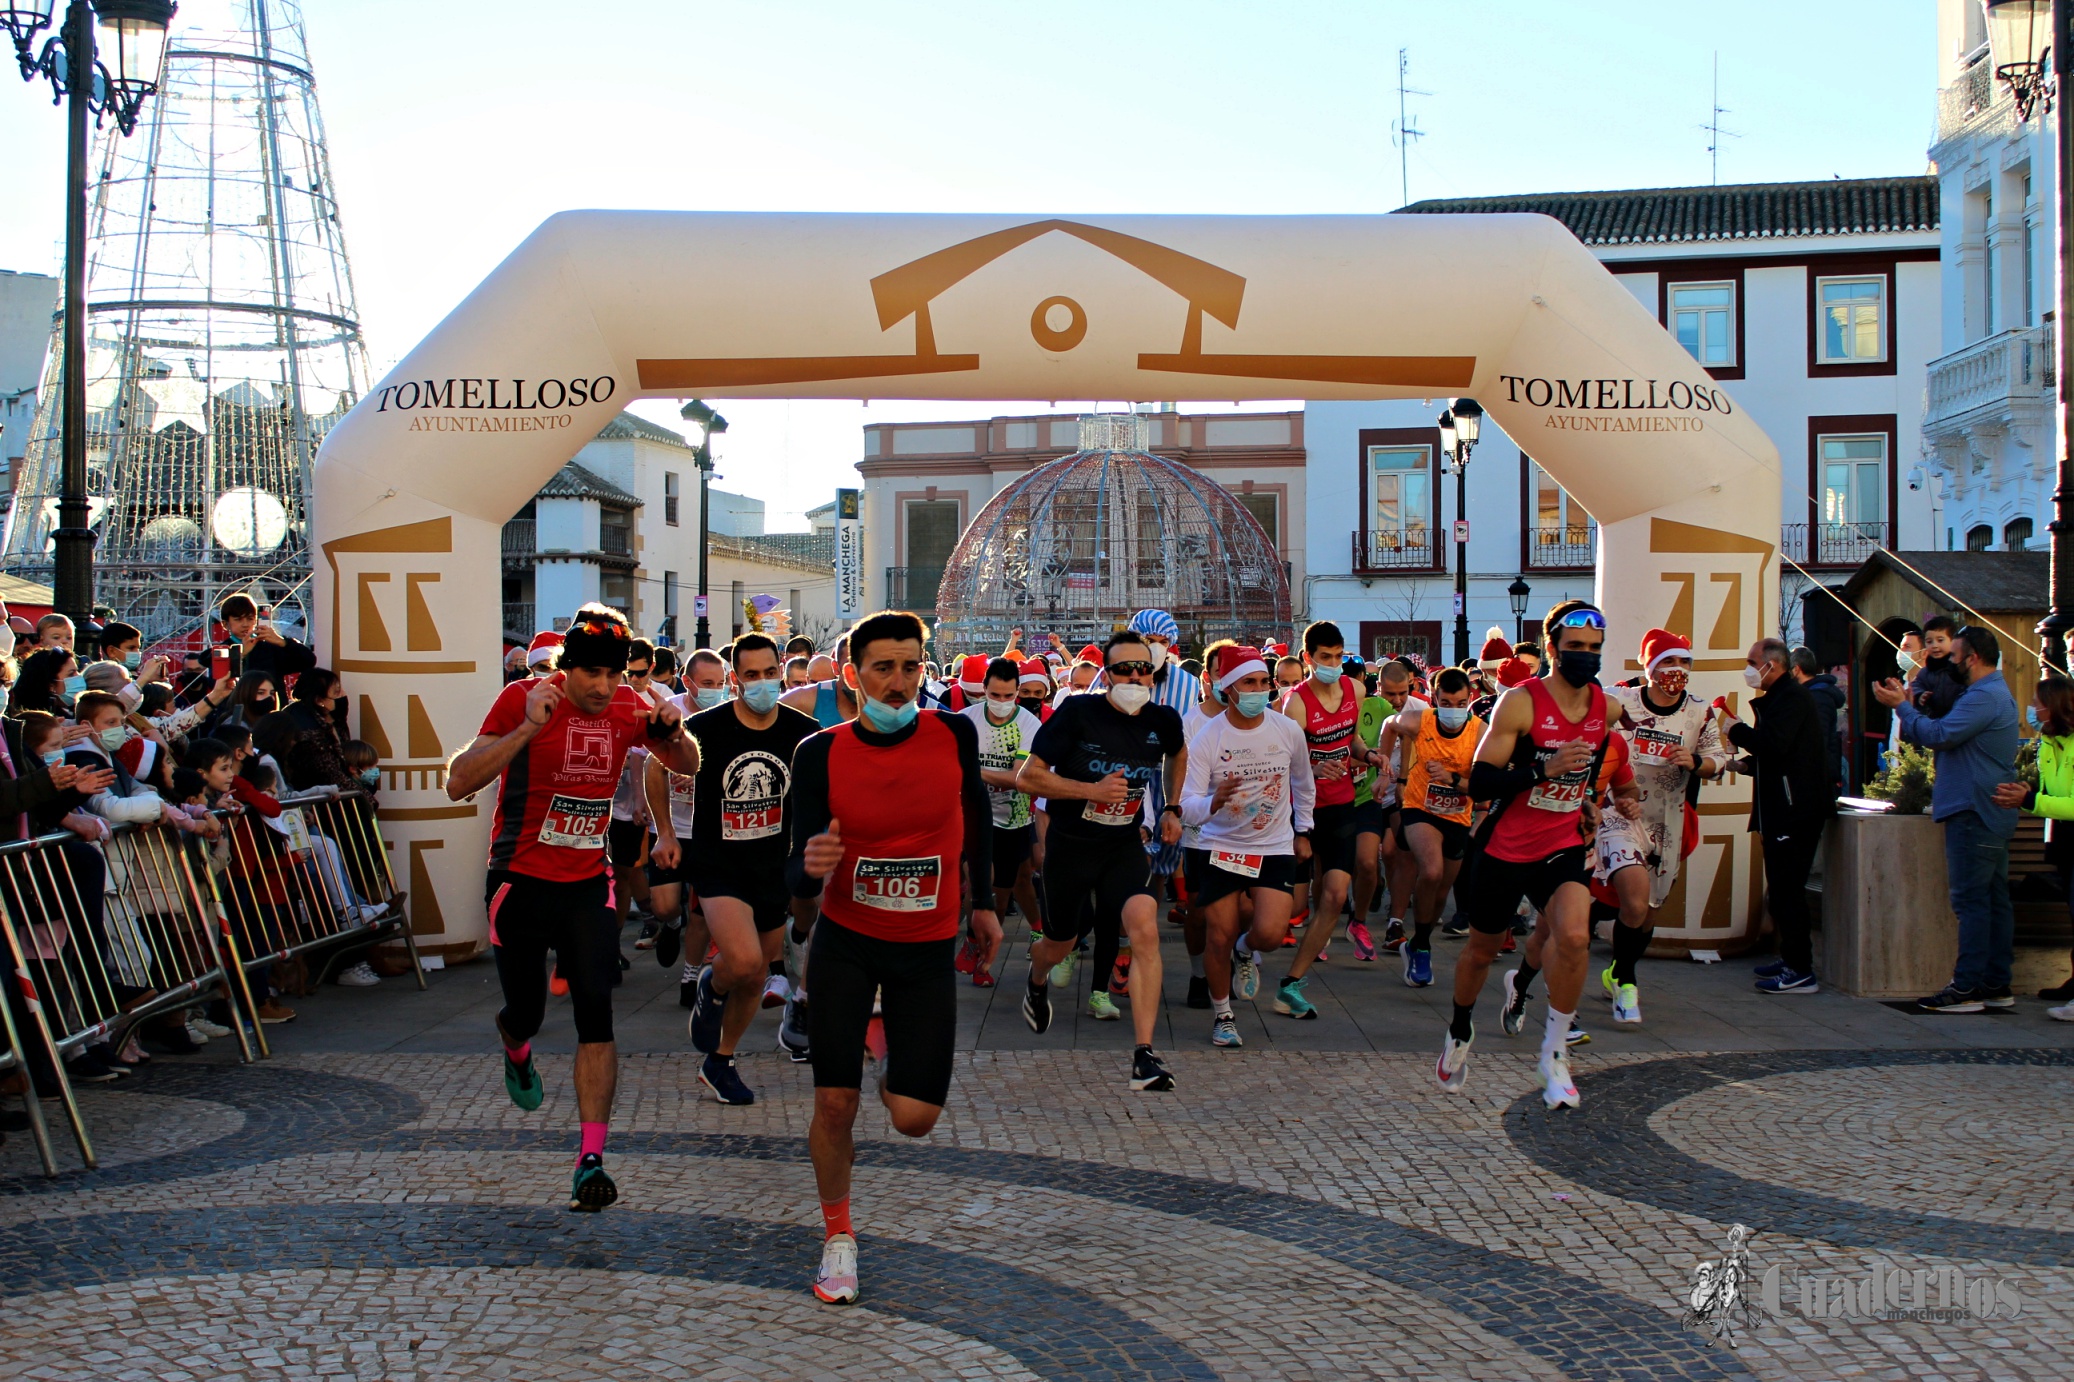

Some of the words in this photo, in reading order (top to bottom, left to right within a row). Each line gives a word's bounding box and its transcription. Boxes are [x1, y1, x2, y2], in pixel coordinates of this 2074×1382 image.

[376, 376, 615, 412] TOMELLOSO
[1500, 375, 1732, 415] TOMELLOSO
[409, 414, 572, 432] AYUNTAMIENTO
[1545, 415, 1703, 432] AYUNTAMIENTO
[841, 526, 851, 594] MANCHEGA
[842, 598, 851, 613] LA
[1030, 639, 1050, 648] STO
[568, 716, 612, 728] Castillo
[1647, 741, 1667, 756] 87
[1223, 770, 1240, 778] Sn
[1545, 783, 1580, 801] 279
[556, 800, 573, 808] San
[1104, 802, 1127, 816] 35
[1434, 796, 1460, 808] 299
[563, 815, 599, 836] 105
[736, 811, 767, 829] 121
[1226, 853, 1247, 864] 34
[861, 864, 880, 872] San
[884, 864, 934, 873] Silvestre
[873, 877, 921, 898] 106
